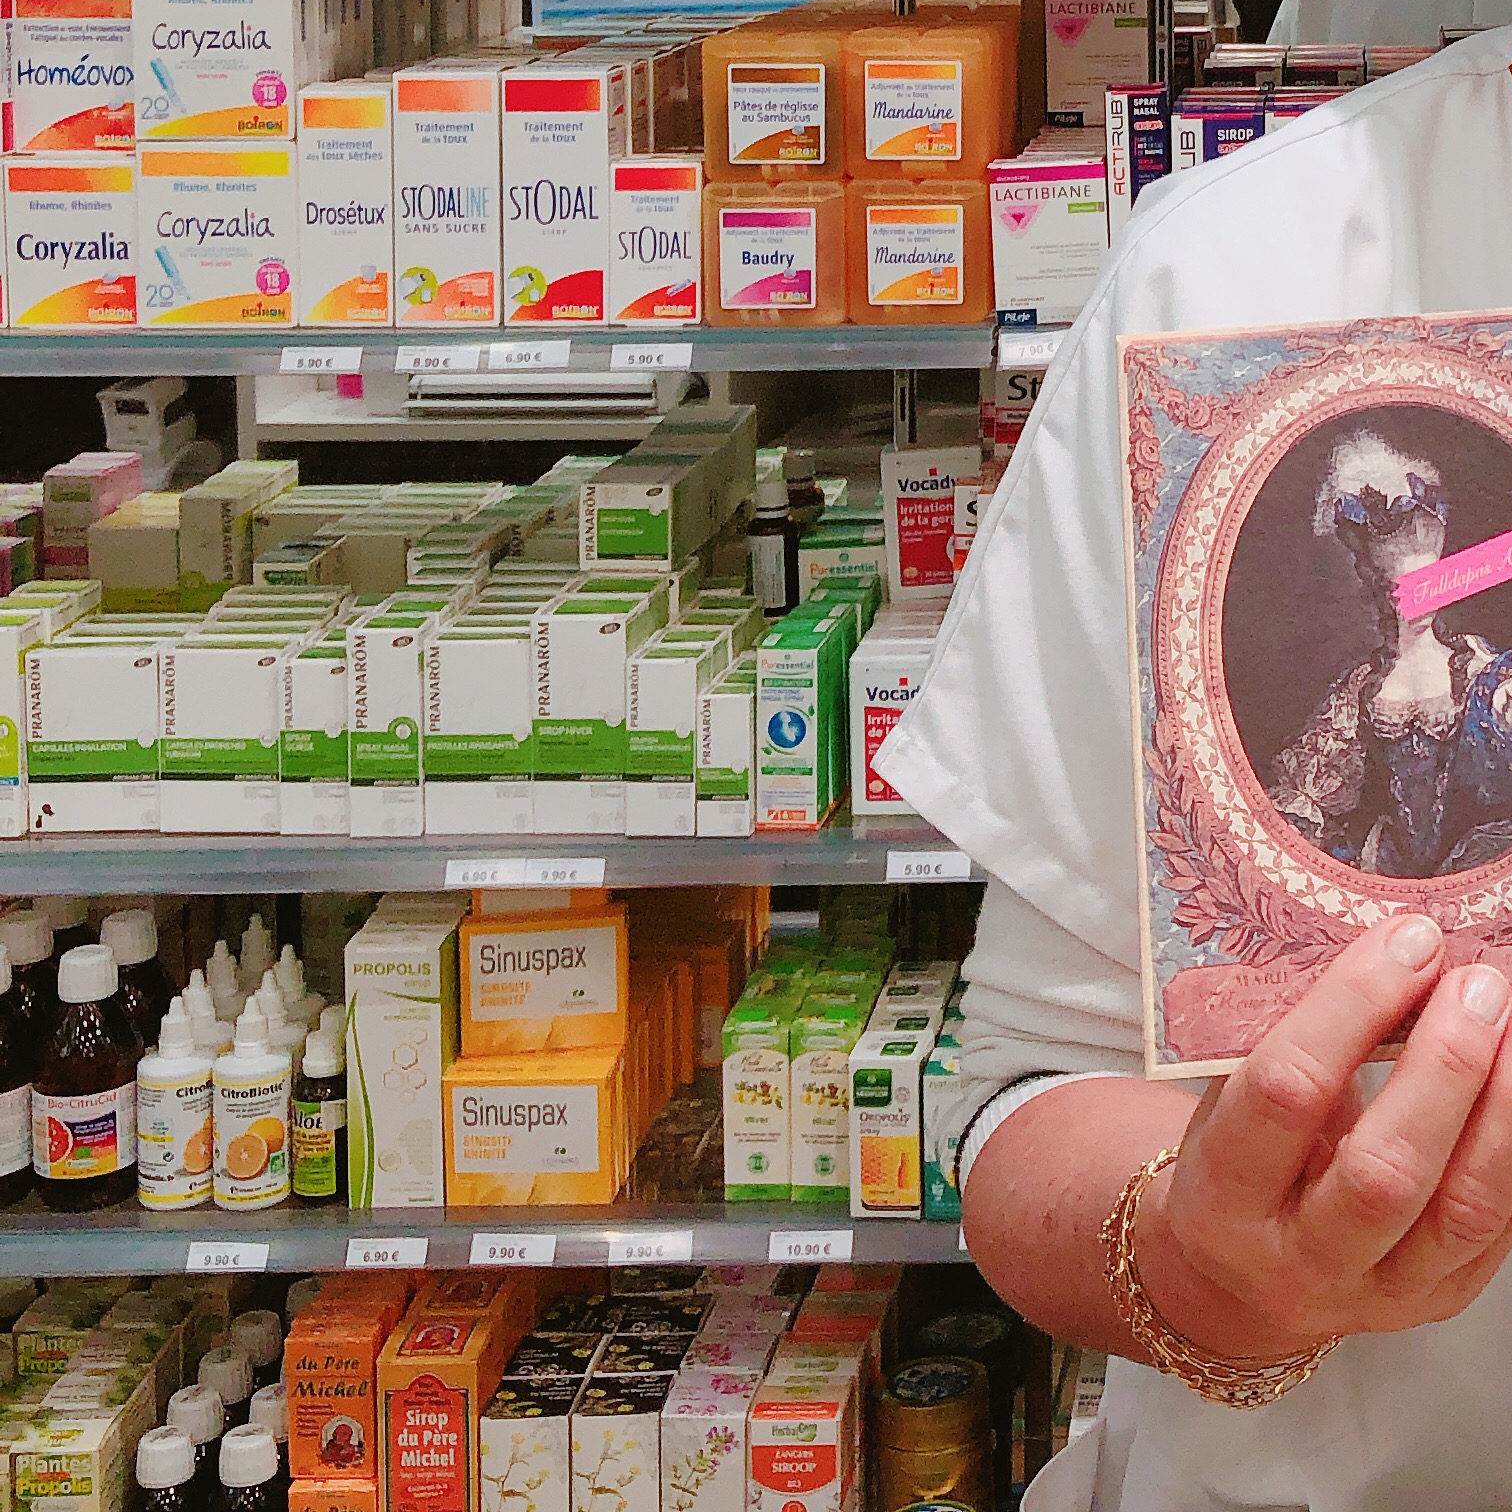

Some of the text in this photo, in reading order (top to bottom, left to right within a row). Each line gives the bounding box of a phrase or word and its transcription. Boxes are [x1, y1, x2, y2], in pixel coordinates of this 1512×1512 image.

[1049, 1, 1136, 16] LACTIBIANE
[152, 20, 271, 57] Coryzalia
[733, 100, 819, 114] Pâtes de réglisse
[873, 101, 954, 120] Mandarine
[741, 111, 811, 123] au Sambucus
[1217, 129, 1254, 141] SIROP
[1113, 100, 1124, 195] ACTIRUB
[401, 185, 489, 219] STODALINE
[509, 180, 598, 224] STODAL
[306, 203, 384, 226] Drosétux
[405, 223, 487, 233] SANS SUCRE
[17, 232, 129, 269] Coryzalia
[741, 249, 794, 269] Baudry
[900, 503, 953, 515] Irritation
[353, 962, 430, 976] PROPOLIS
[480, 945, 587, 976] Sinuspax
[821, 1244, 831, 1255] €
[406, 1410, 449, 1428] Sirop
[398, 1430, 458, 1446] du Père
[401, 1449, 455, 1467] Michel
